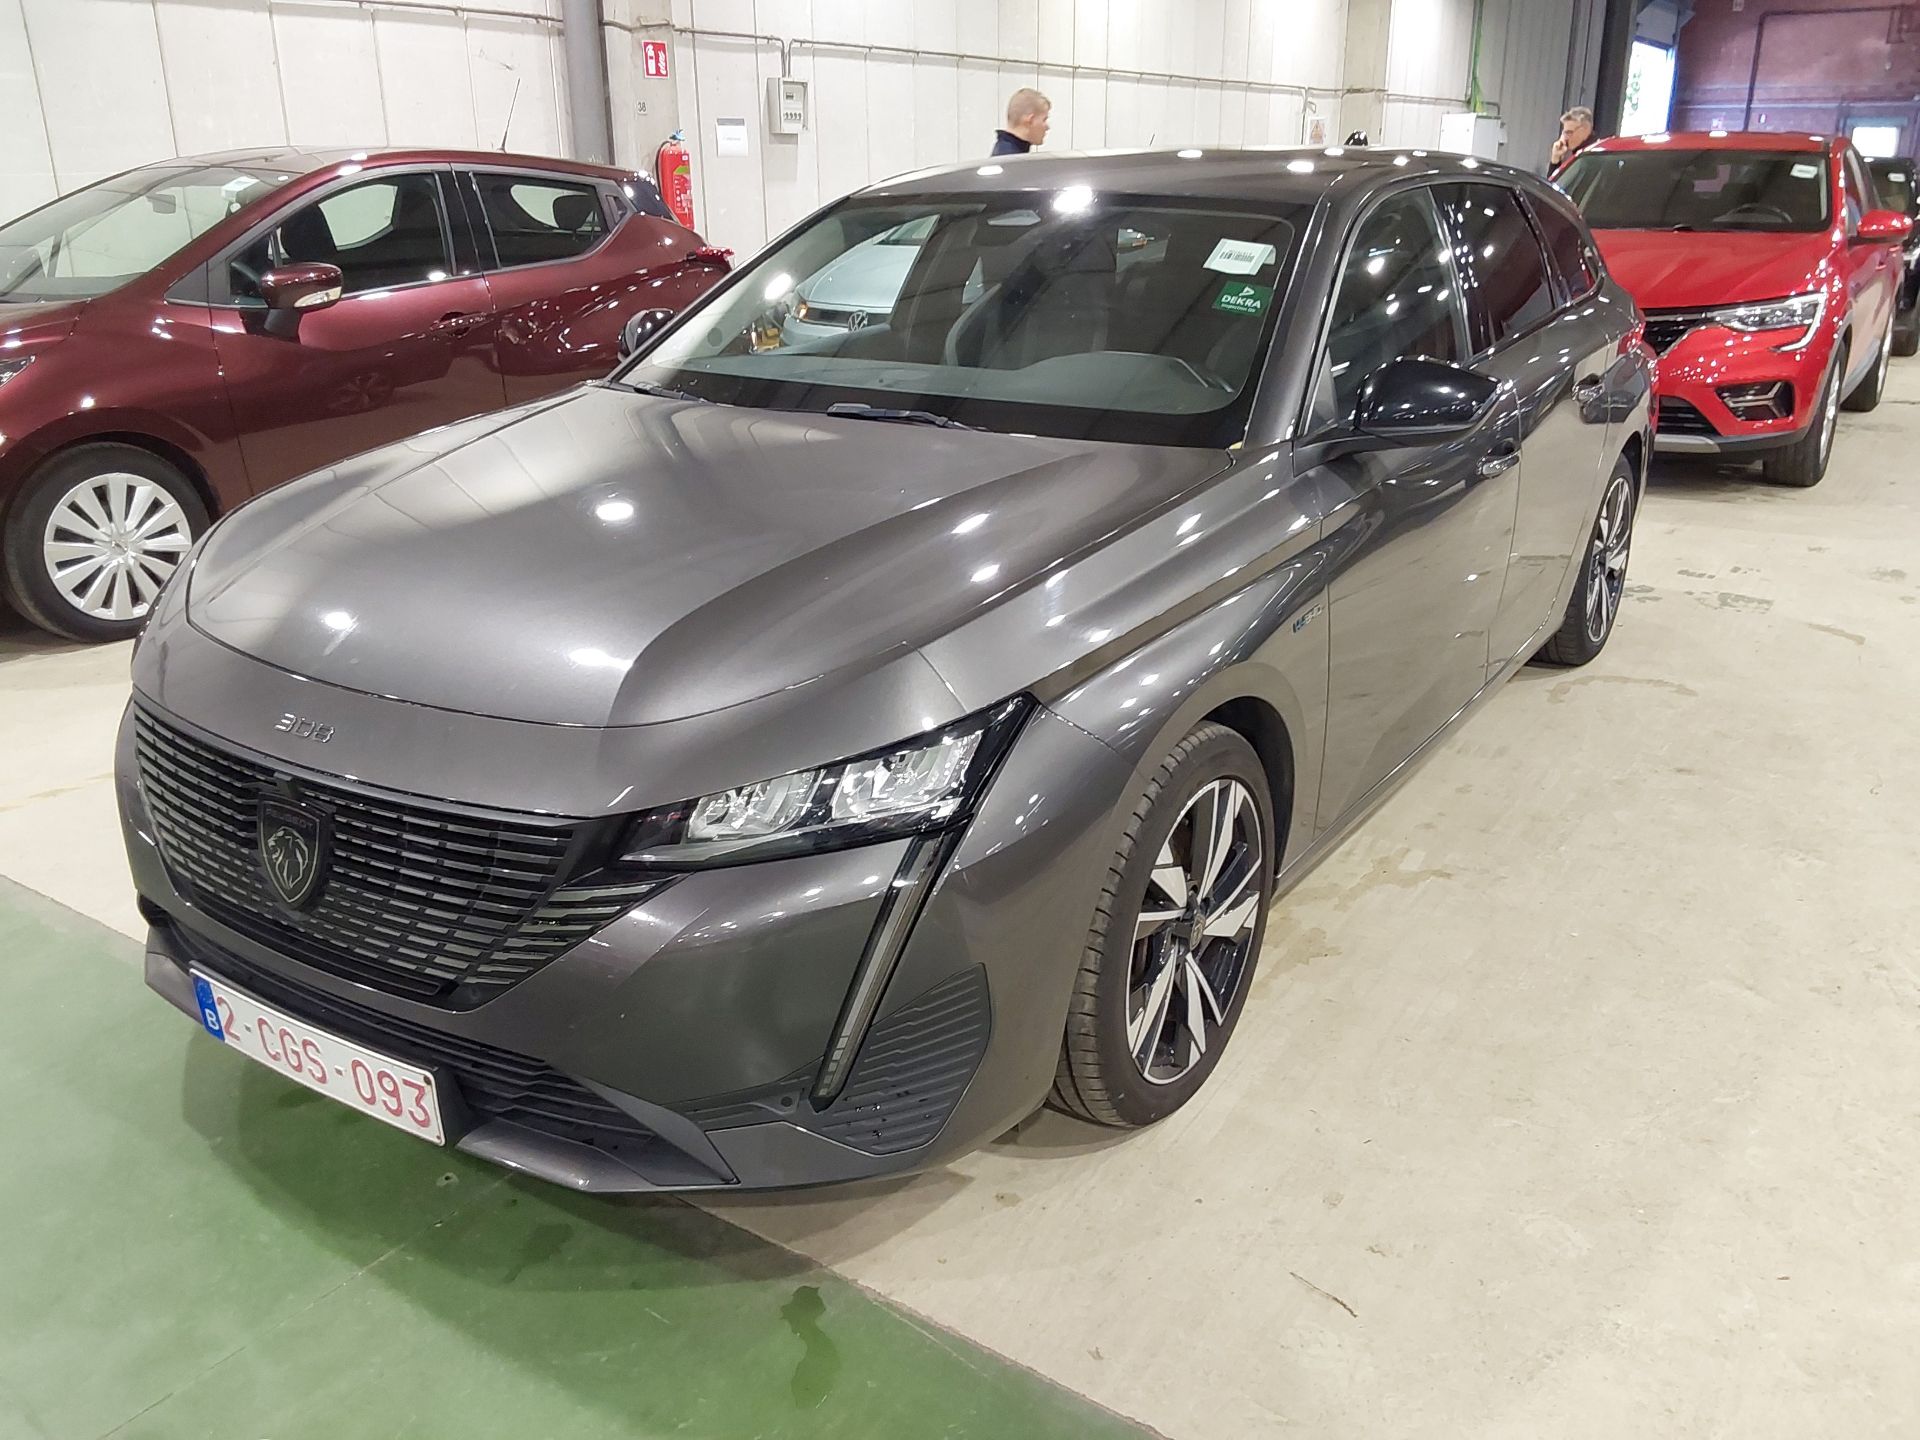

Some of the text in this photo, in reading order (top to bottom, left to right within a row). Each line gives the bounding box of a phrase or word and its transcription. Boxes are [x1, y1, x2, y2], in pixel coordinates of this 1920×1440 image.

[637, 101, 647, 113] 38
[1220, 294, 1261, 309] DEKRA
[274, 712, 336, 744] 308
[204, 1007, 221, 1032] B
[216, 995, 431, 1129] 2-CGS-093
